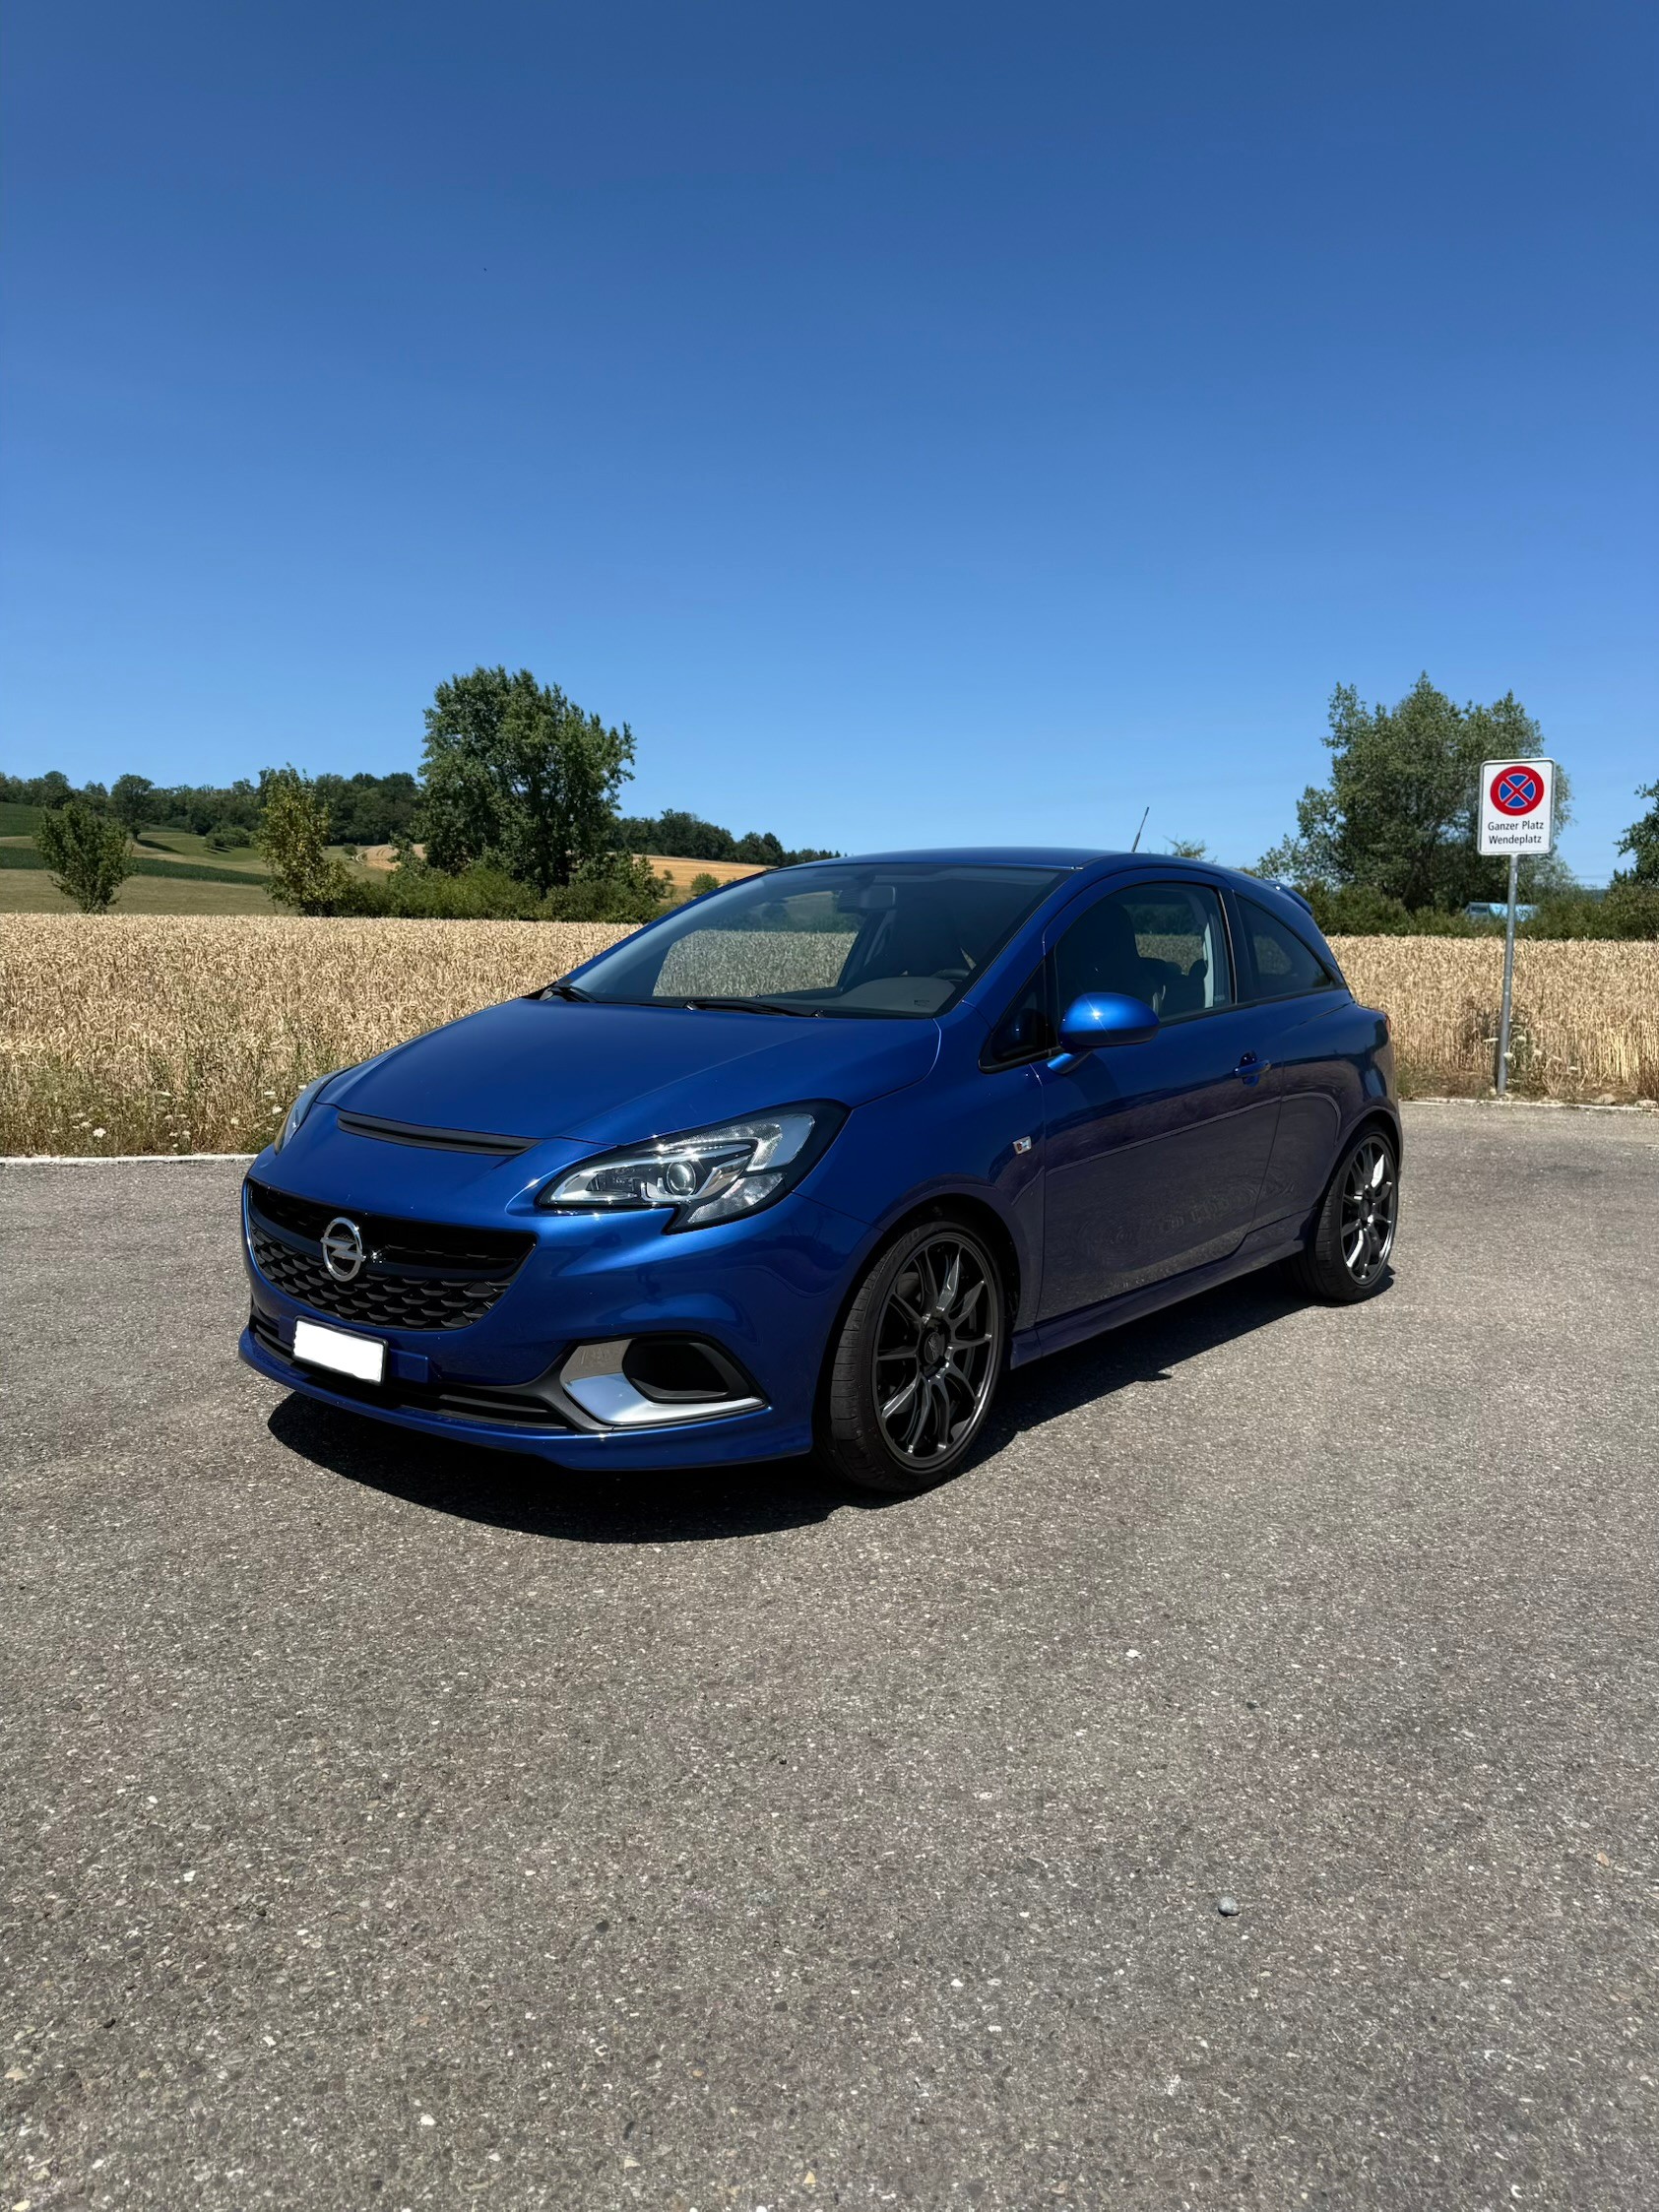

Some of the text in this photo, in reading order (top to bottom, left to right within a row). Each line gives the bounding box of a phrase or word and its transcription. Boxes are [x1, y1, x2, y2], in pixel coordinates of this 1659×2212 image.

[1488, 820, 1544, 831] Ganzer Platz
[1489, 834, 1542, 846] Wendeplatz
